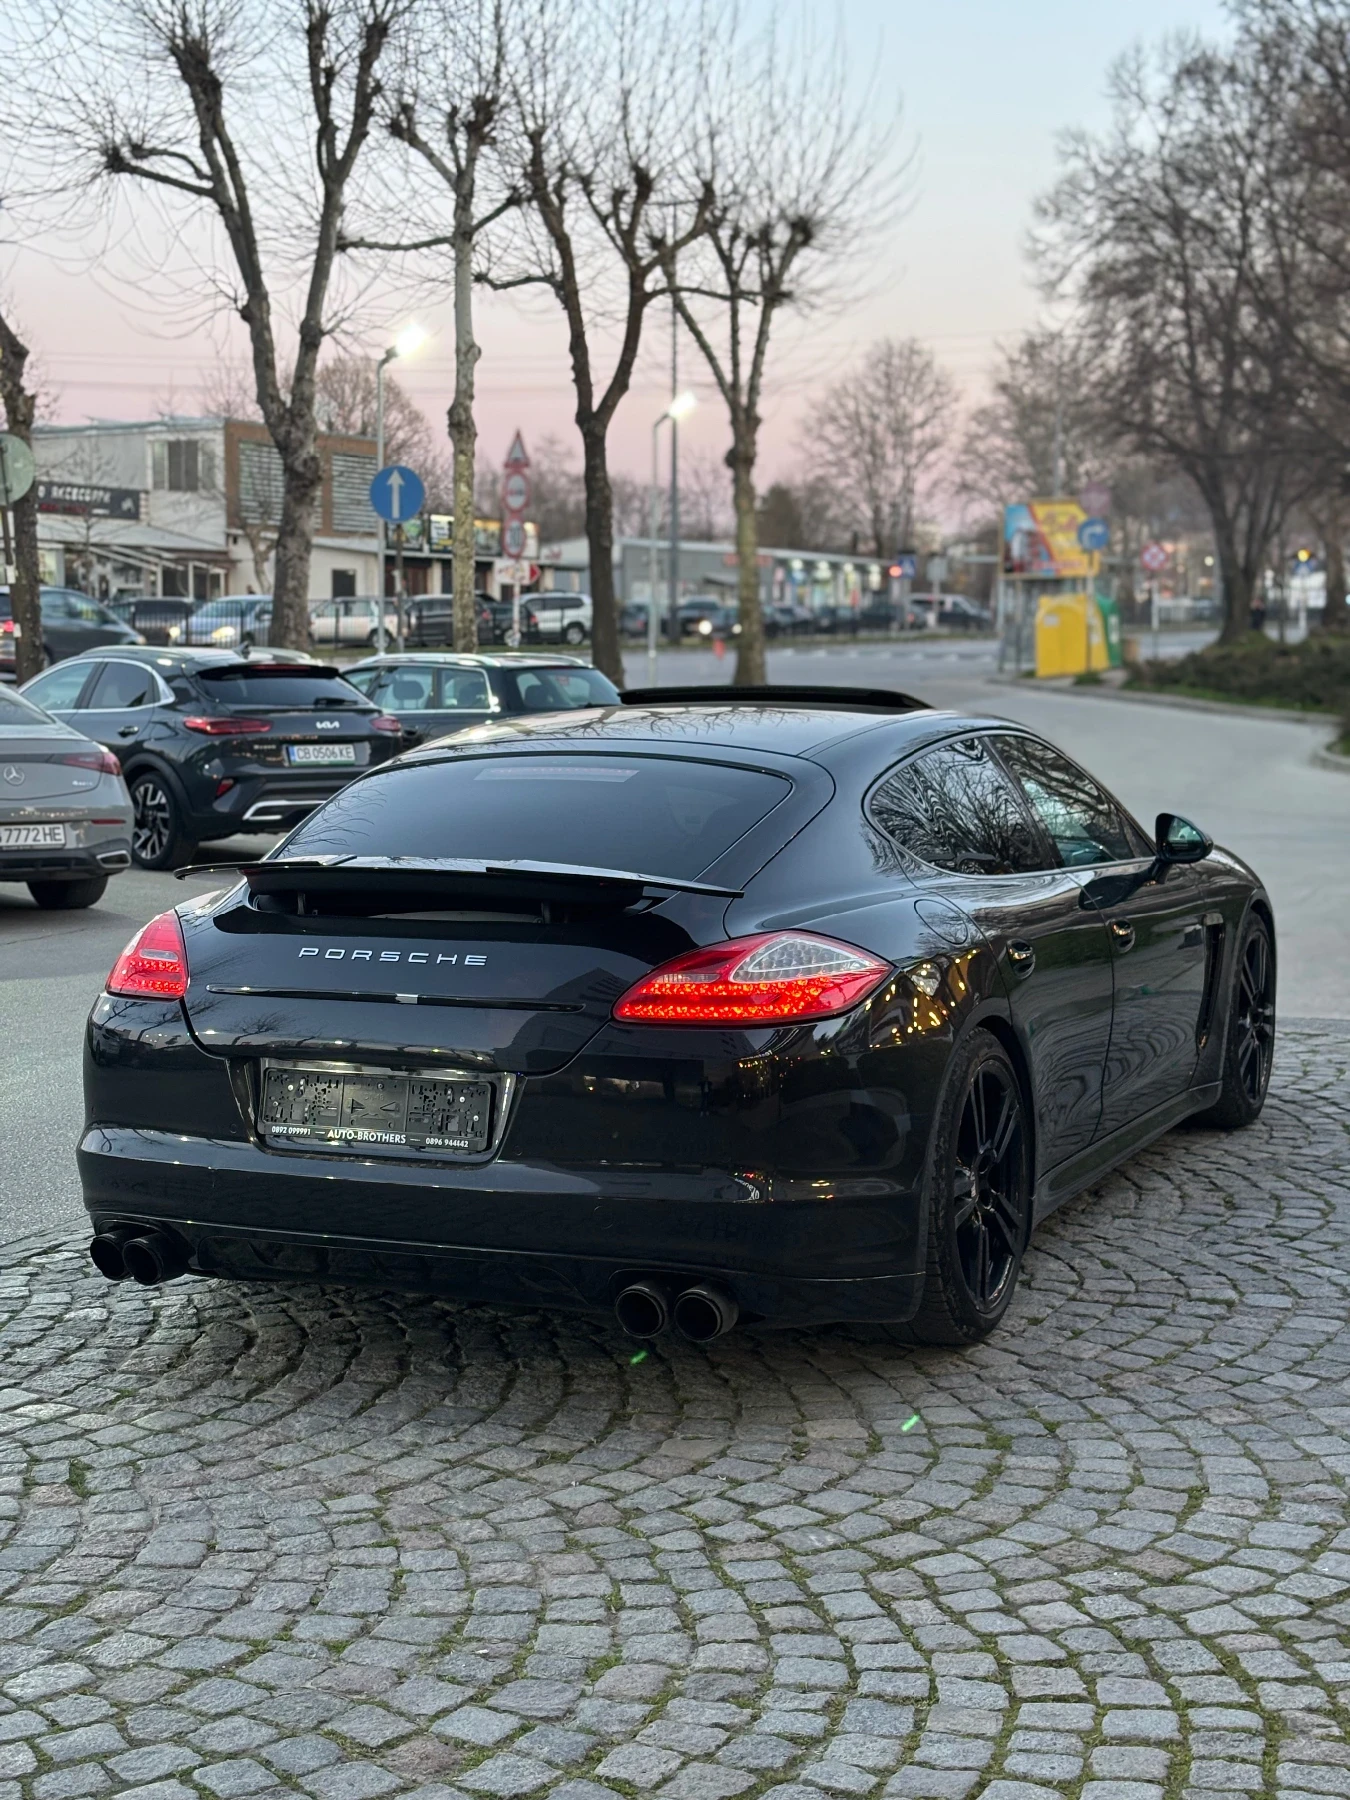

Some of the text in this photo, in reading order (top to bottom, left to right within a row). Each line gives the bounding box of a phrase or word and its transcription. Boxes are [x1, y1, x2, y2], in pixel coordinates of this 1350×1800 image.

[296, 745, 353, 760] CB 0506 KE
[4, 826, 41, 843] 7772
[42, 826, 62, 842] HE
[298, 947, 488, 966] PORSCHE
[271, 1126, 287, 1134] 0892
[327, 1129, 407, 1144] AUTO-BROTHERS
[425, 1137, 443, 1146] 0896
